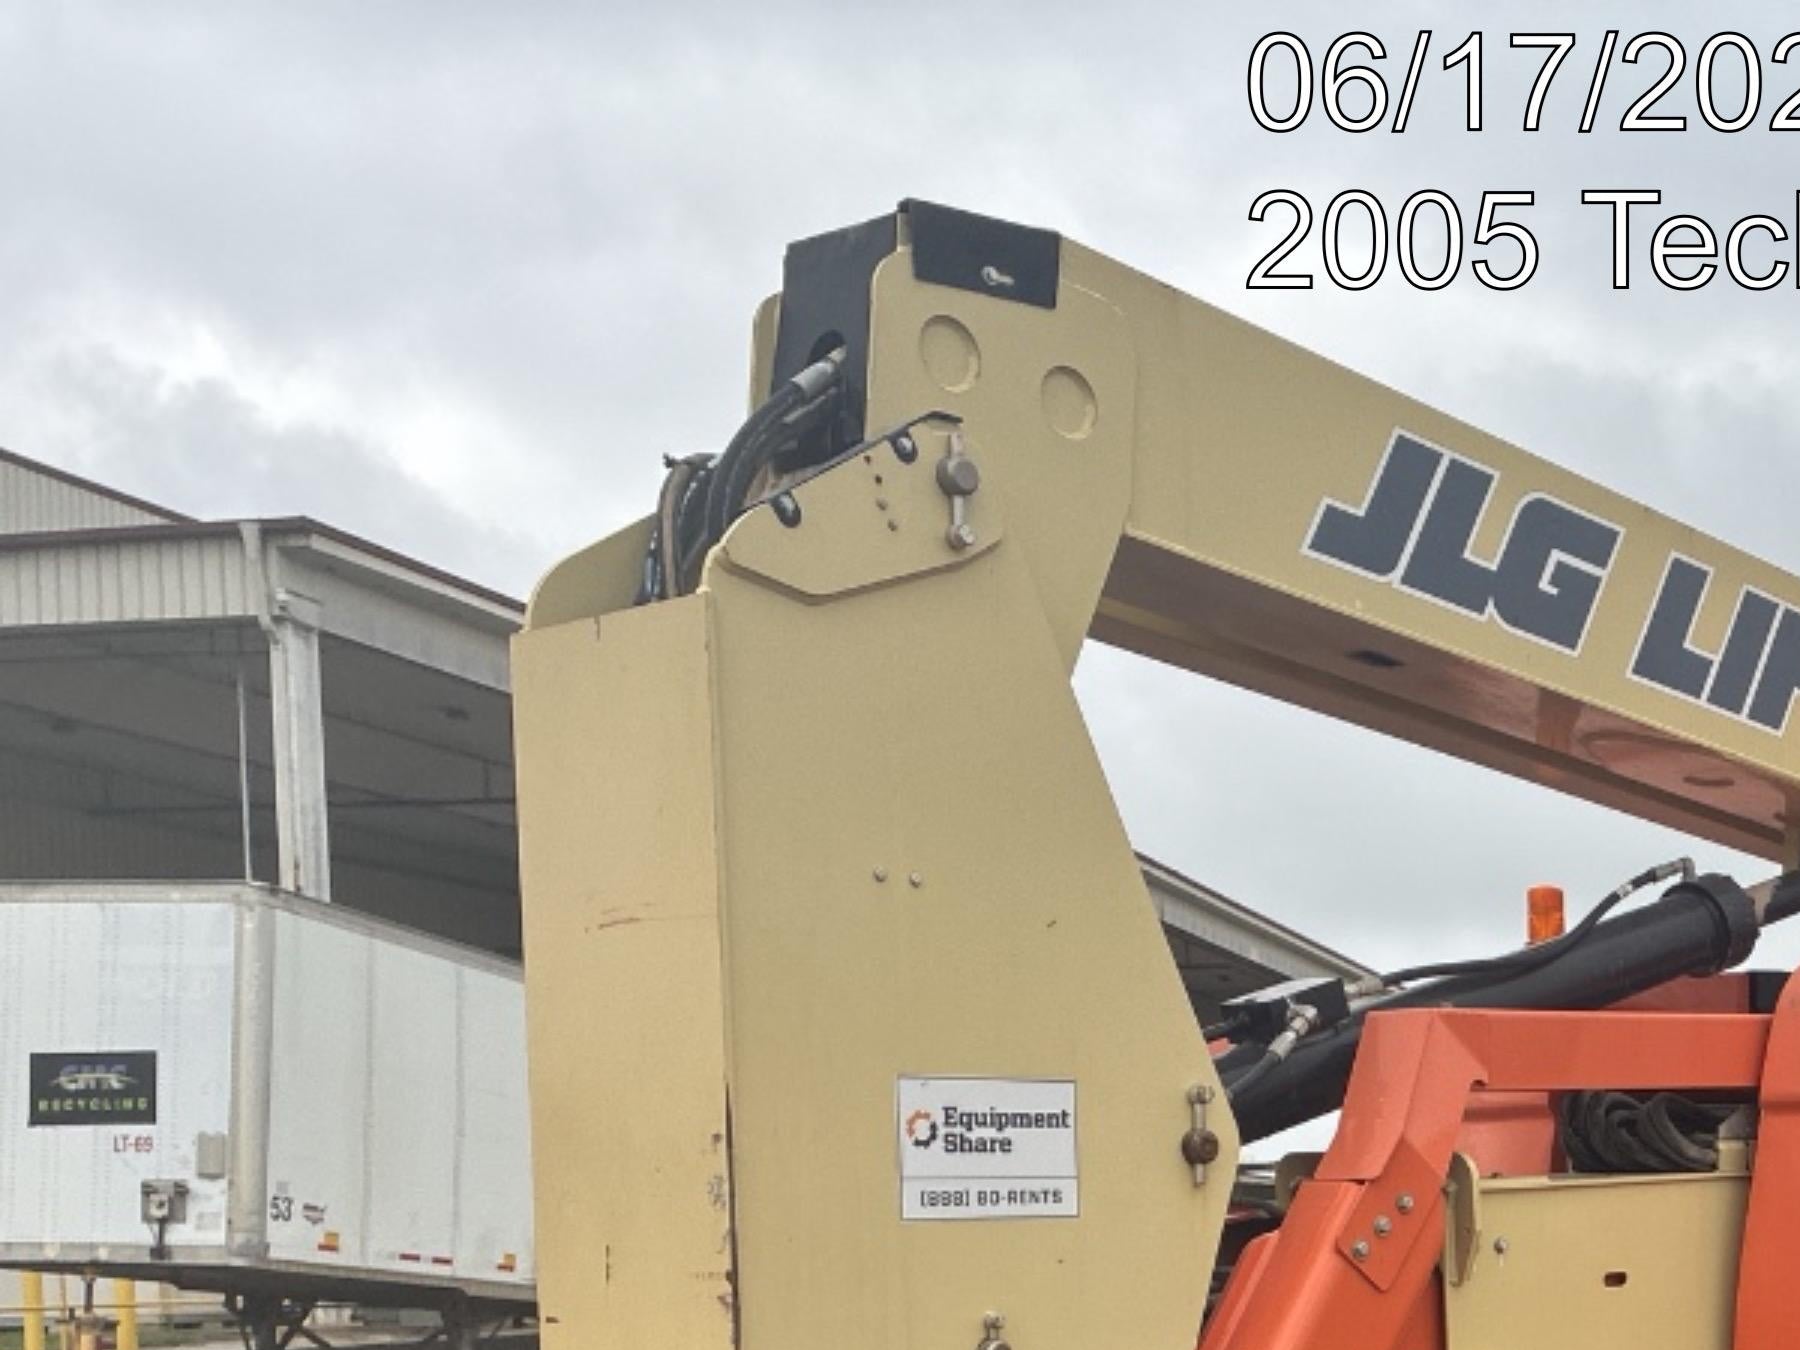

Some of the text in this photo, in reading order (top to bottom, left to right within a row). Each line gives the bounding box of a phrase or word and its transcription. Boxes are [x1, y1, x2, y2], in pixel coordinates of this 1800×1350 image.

[1300, 426, 1625, 657] JLG
[942, 1106, 1071, 1132] Equipment
[943, 1132, 1012, 1153] Share
